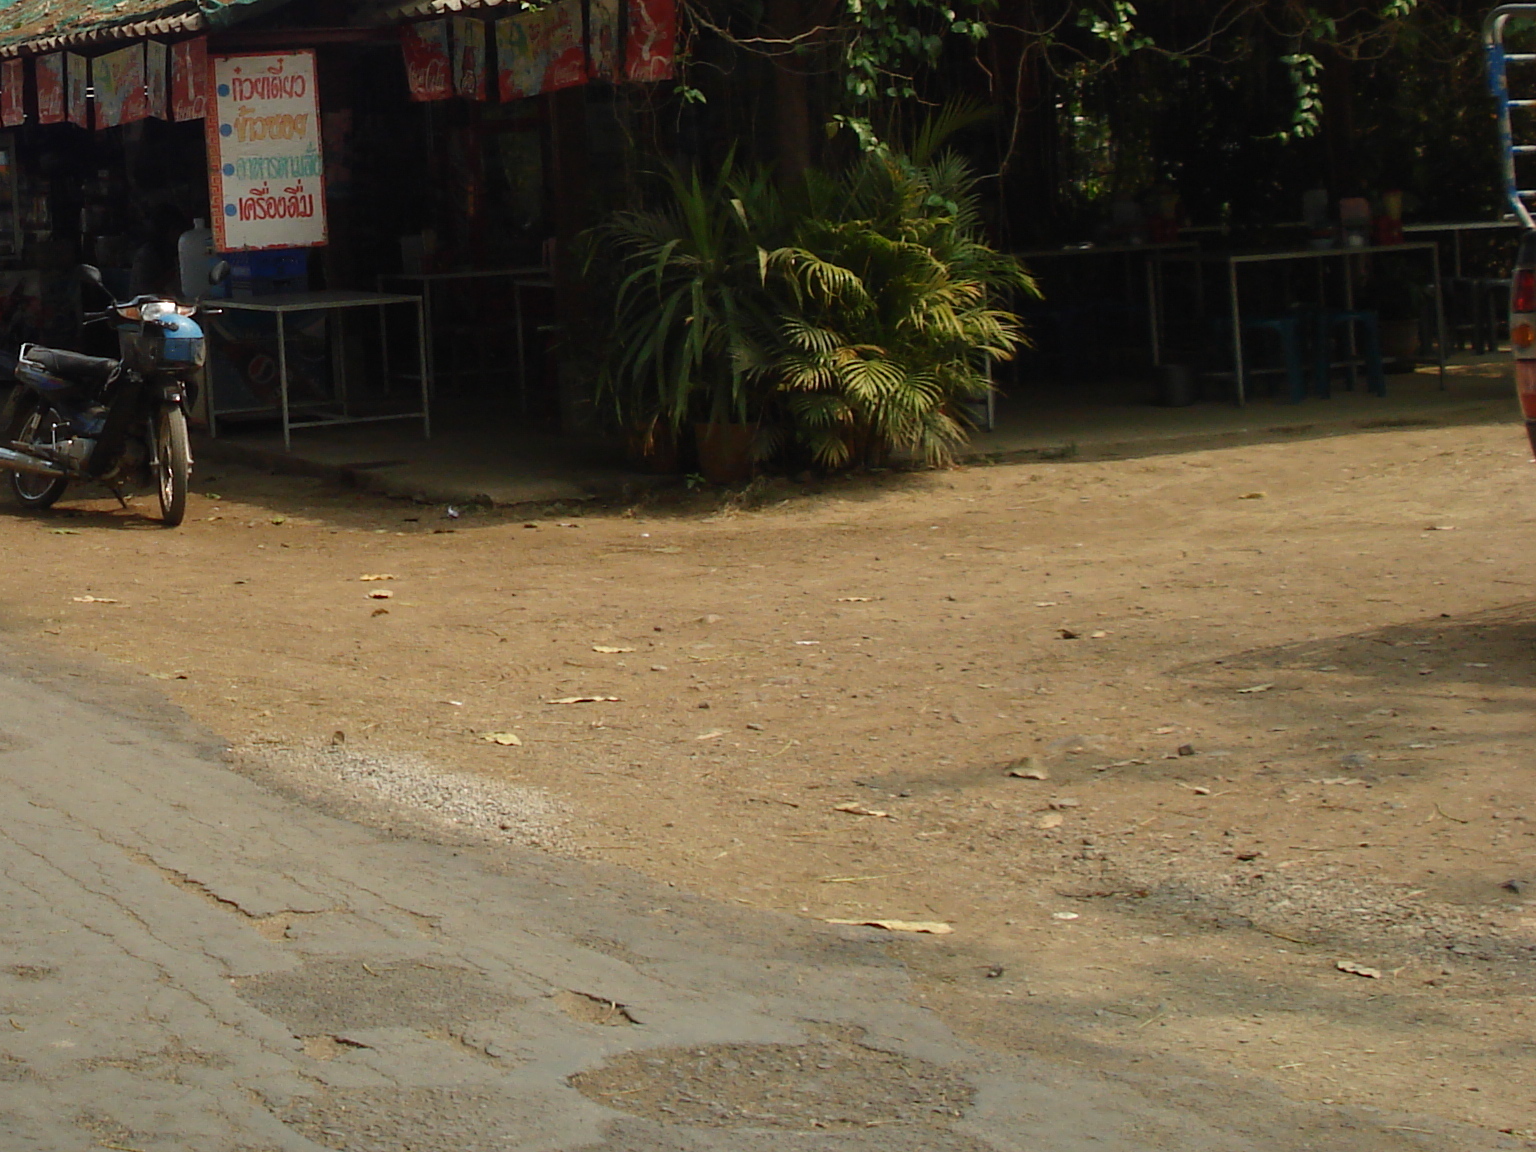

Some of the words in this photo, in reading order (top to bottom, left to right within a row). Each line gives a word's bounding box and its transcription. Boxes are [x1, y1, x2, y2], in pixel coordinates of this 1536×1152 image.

[231, 57, 307, 102] ก๋วยเตี๋ยว
[233, 104, 309, 143] ข้าวซอย
[235, 141, 323, 181] อาหารตามสั่ง
[238, 178, 314, 221] เครื่องดื่ม
